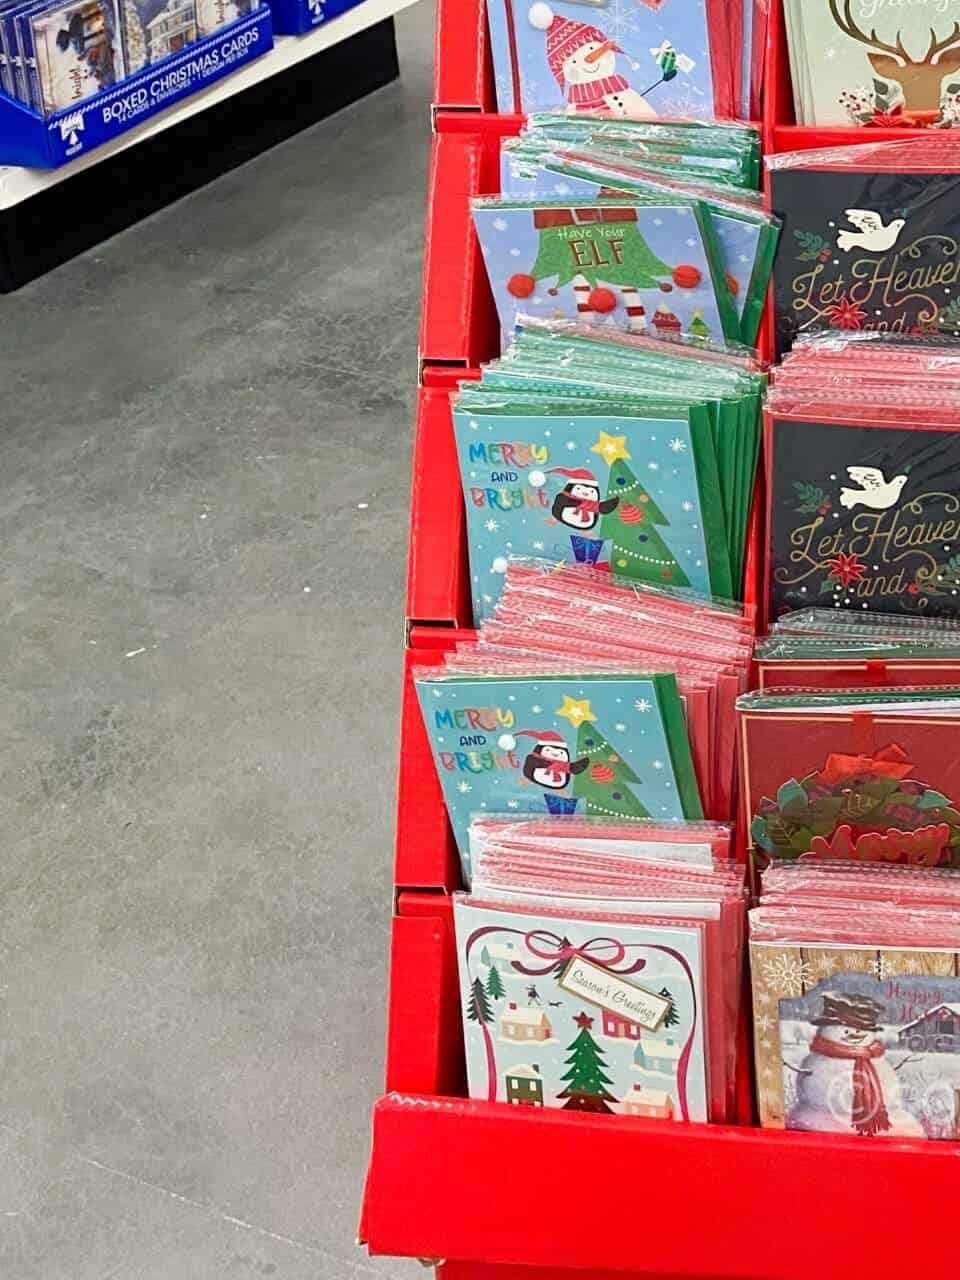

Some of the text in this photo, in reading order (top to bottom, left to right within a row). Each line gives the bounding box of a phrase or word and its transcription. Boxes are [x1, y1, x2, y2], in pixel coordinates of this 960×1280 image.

[102, 27, 259, 123] BOXED CHRISTMAS CARDS
[557, 226, 594, 241] Have
[570, 237, 626, 270] ELF
[792, 264, 848, 312] Let
[490, 470, 519, 483] AND
[789, 516, 846, 563] Let
[857, 568, 909, 598] and
[459, 734, 487, 747] AND
